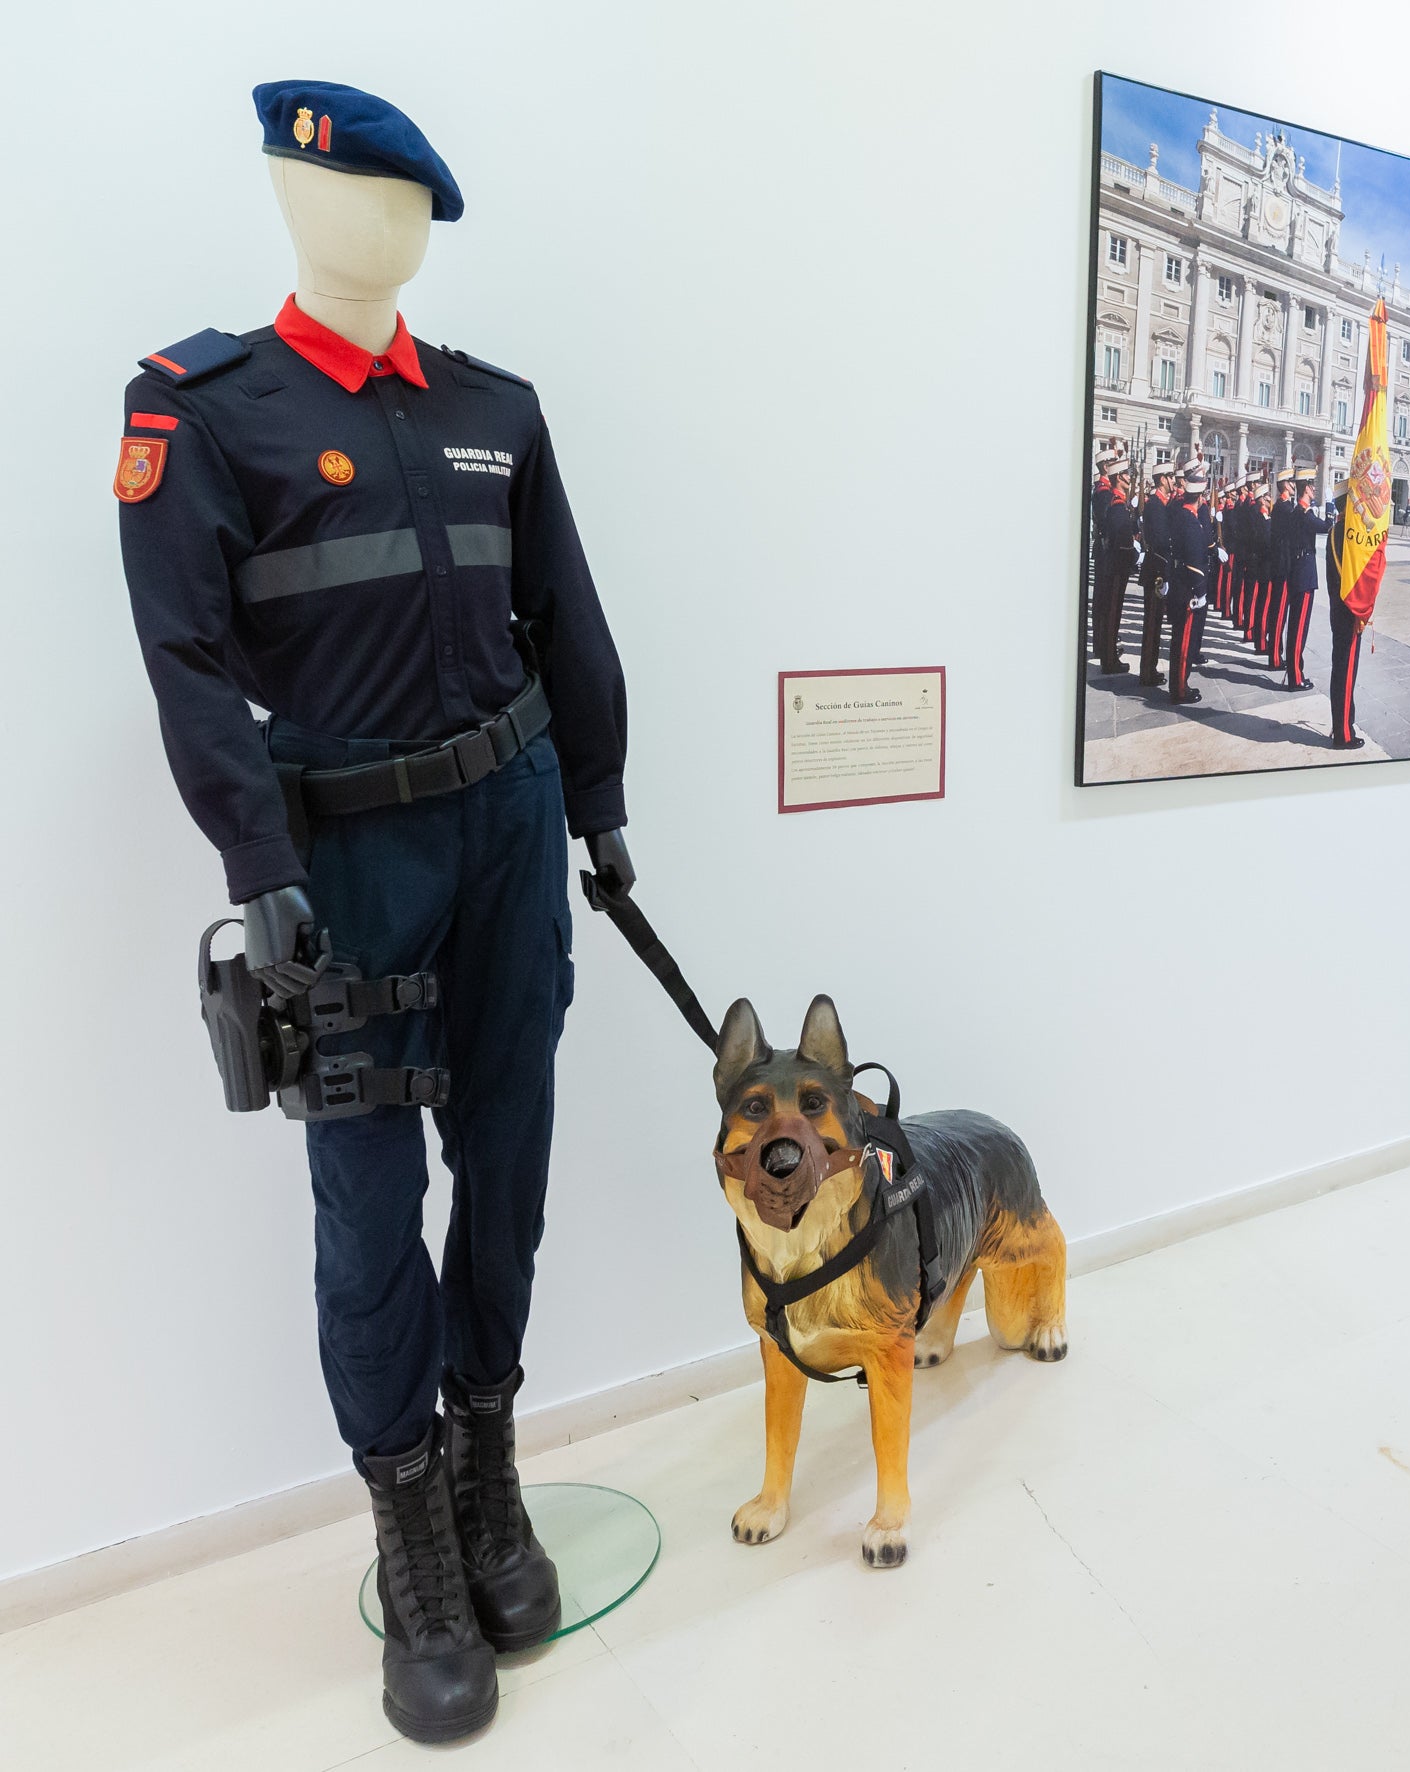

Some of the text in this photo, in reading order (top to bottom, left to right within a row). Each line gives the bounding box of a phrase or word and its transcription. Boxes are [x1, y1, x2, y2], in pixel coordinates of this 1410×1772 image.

[443, 447, 513, 465] GUARDIA REAL
[452, 461, 488, 473] POLICIA
[843, 701, 852, 709] de
[875, 699, 903, 708] Caninos
